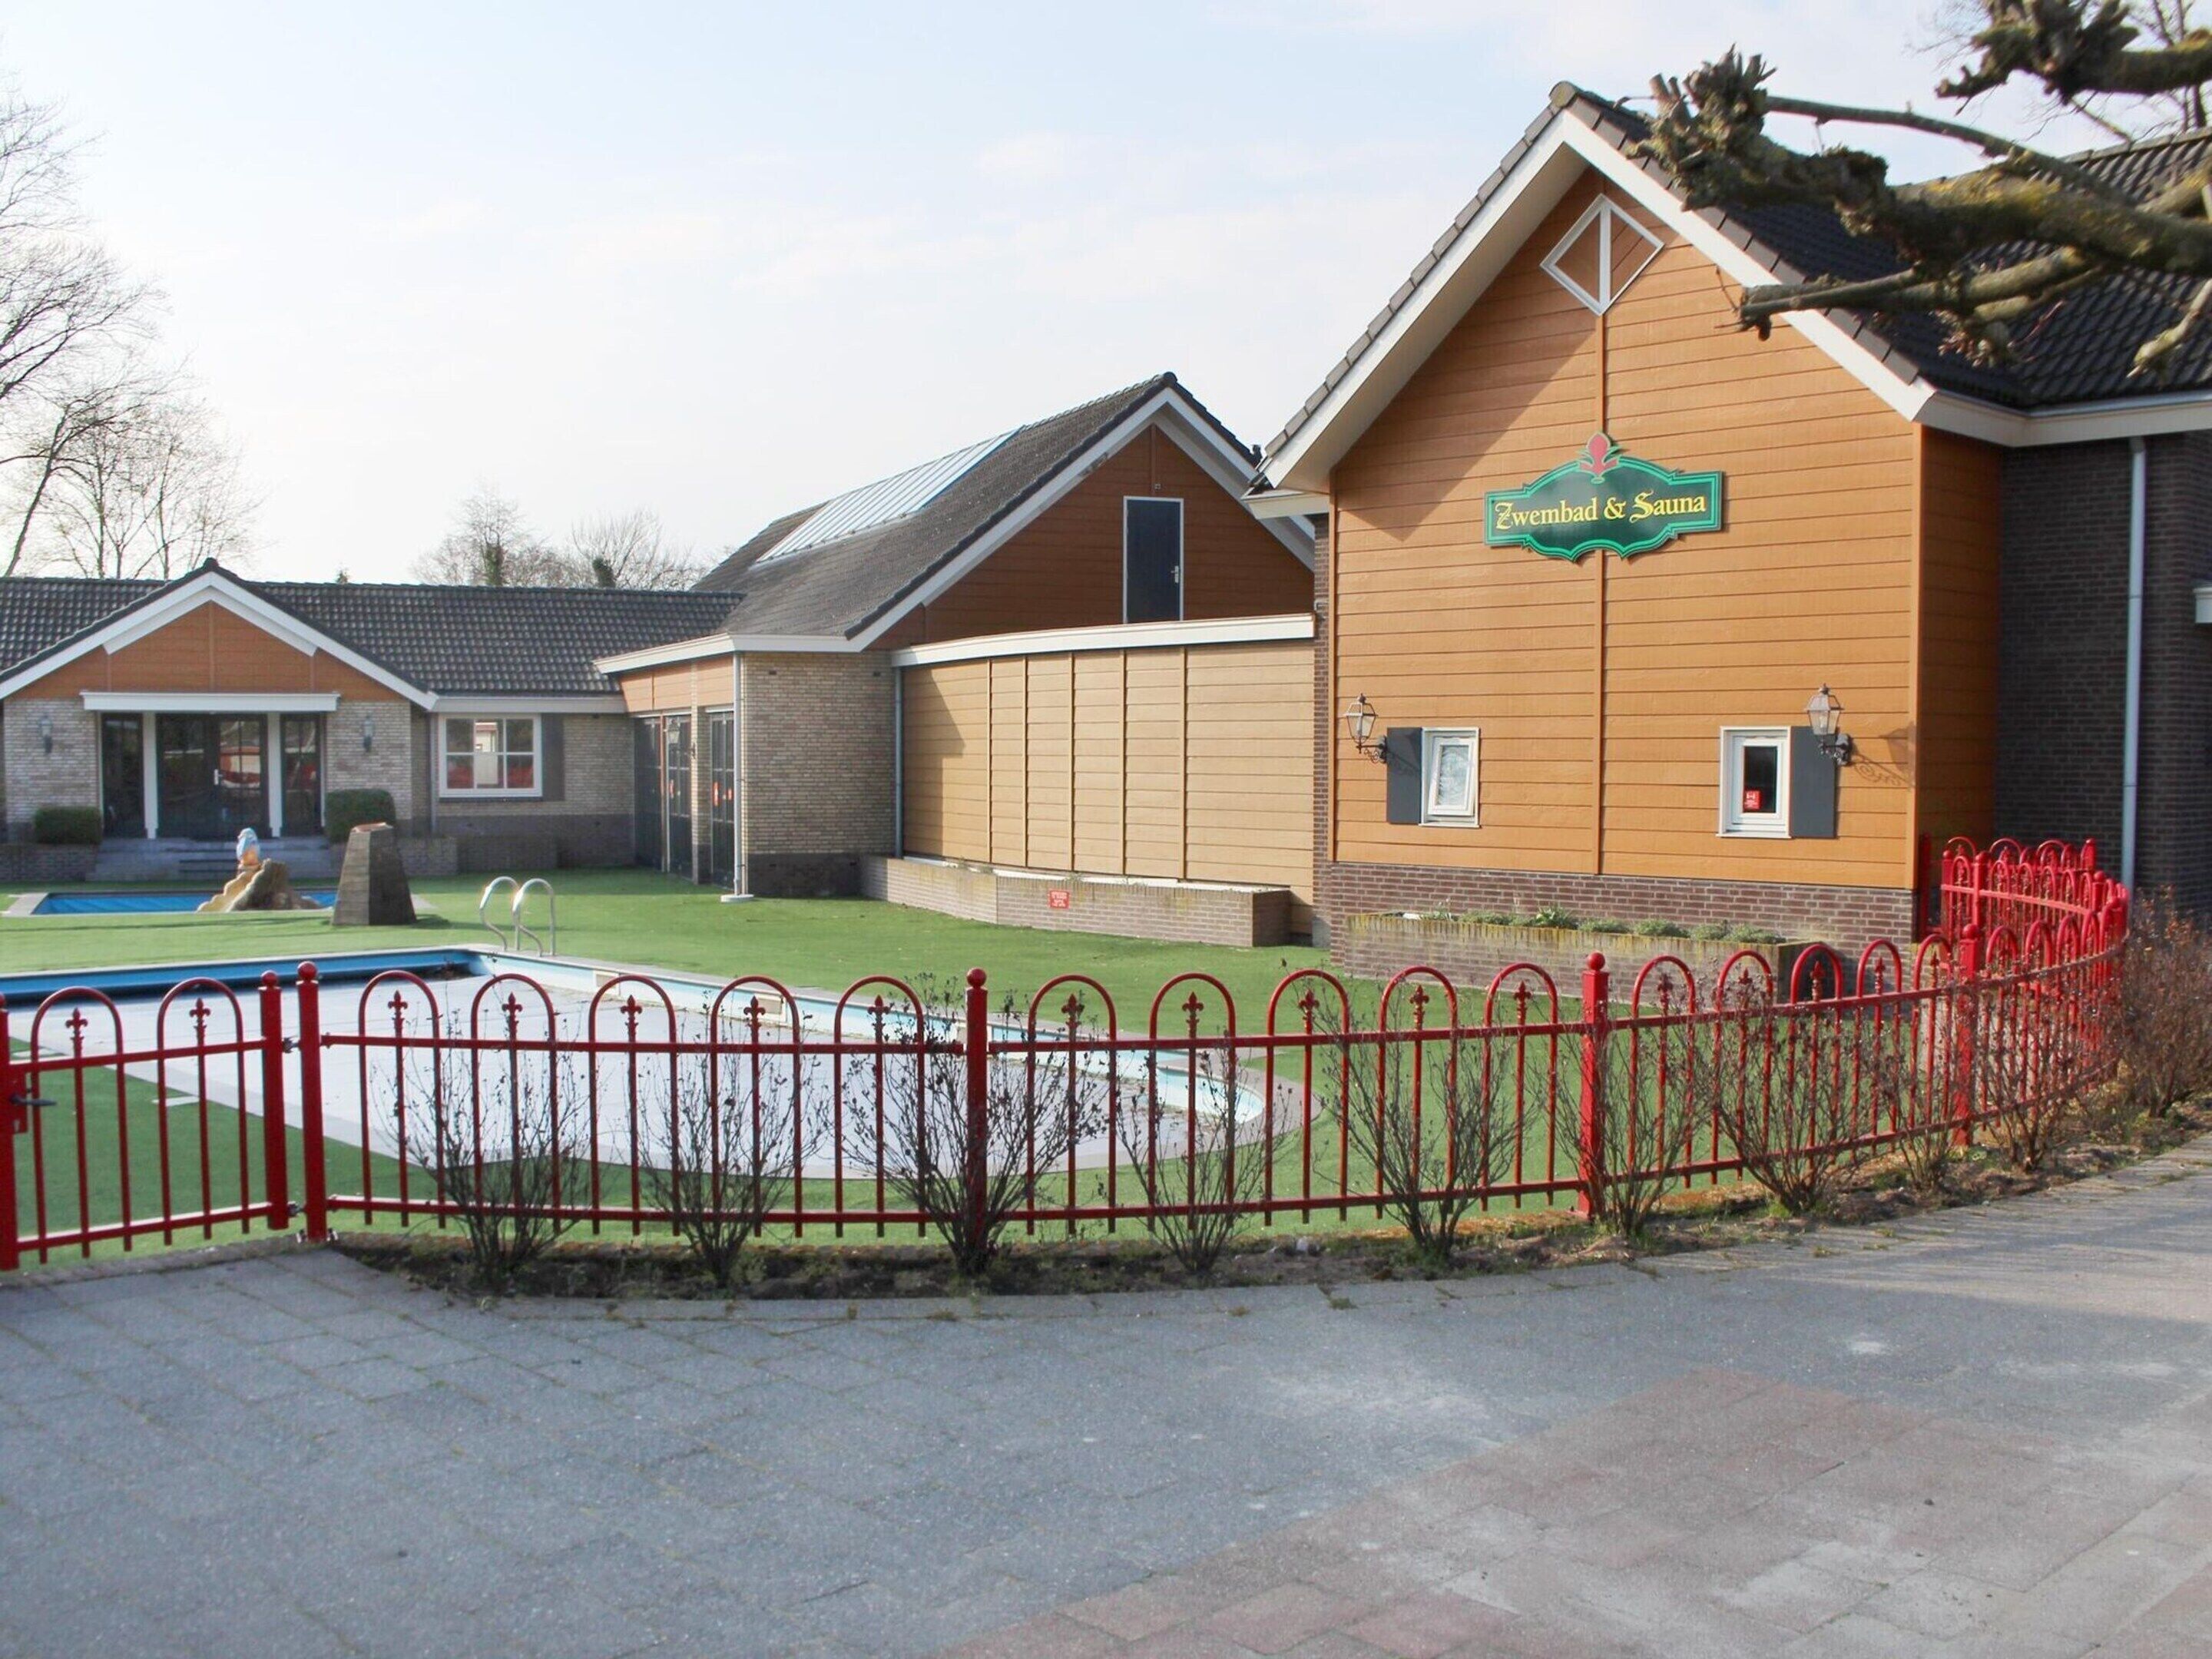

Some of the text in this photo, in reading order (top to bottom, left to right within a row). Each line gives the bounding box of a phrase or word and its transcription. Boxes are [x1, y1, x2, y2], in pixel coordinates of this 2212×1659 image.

[1495, 489, 1707, 530] Zwembad & Sauna
